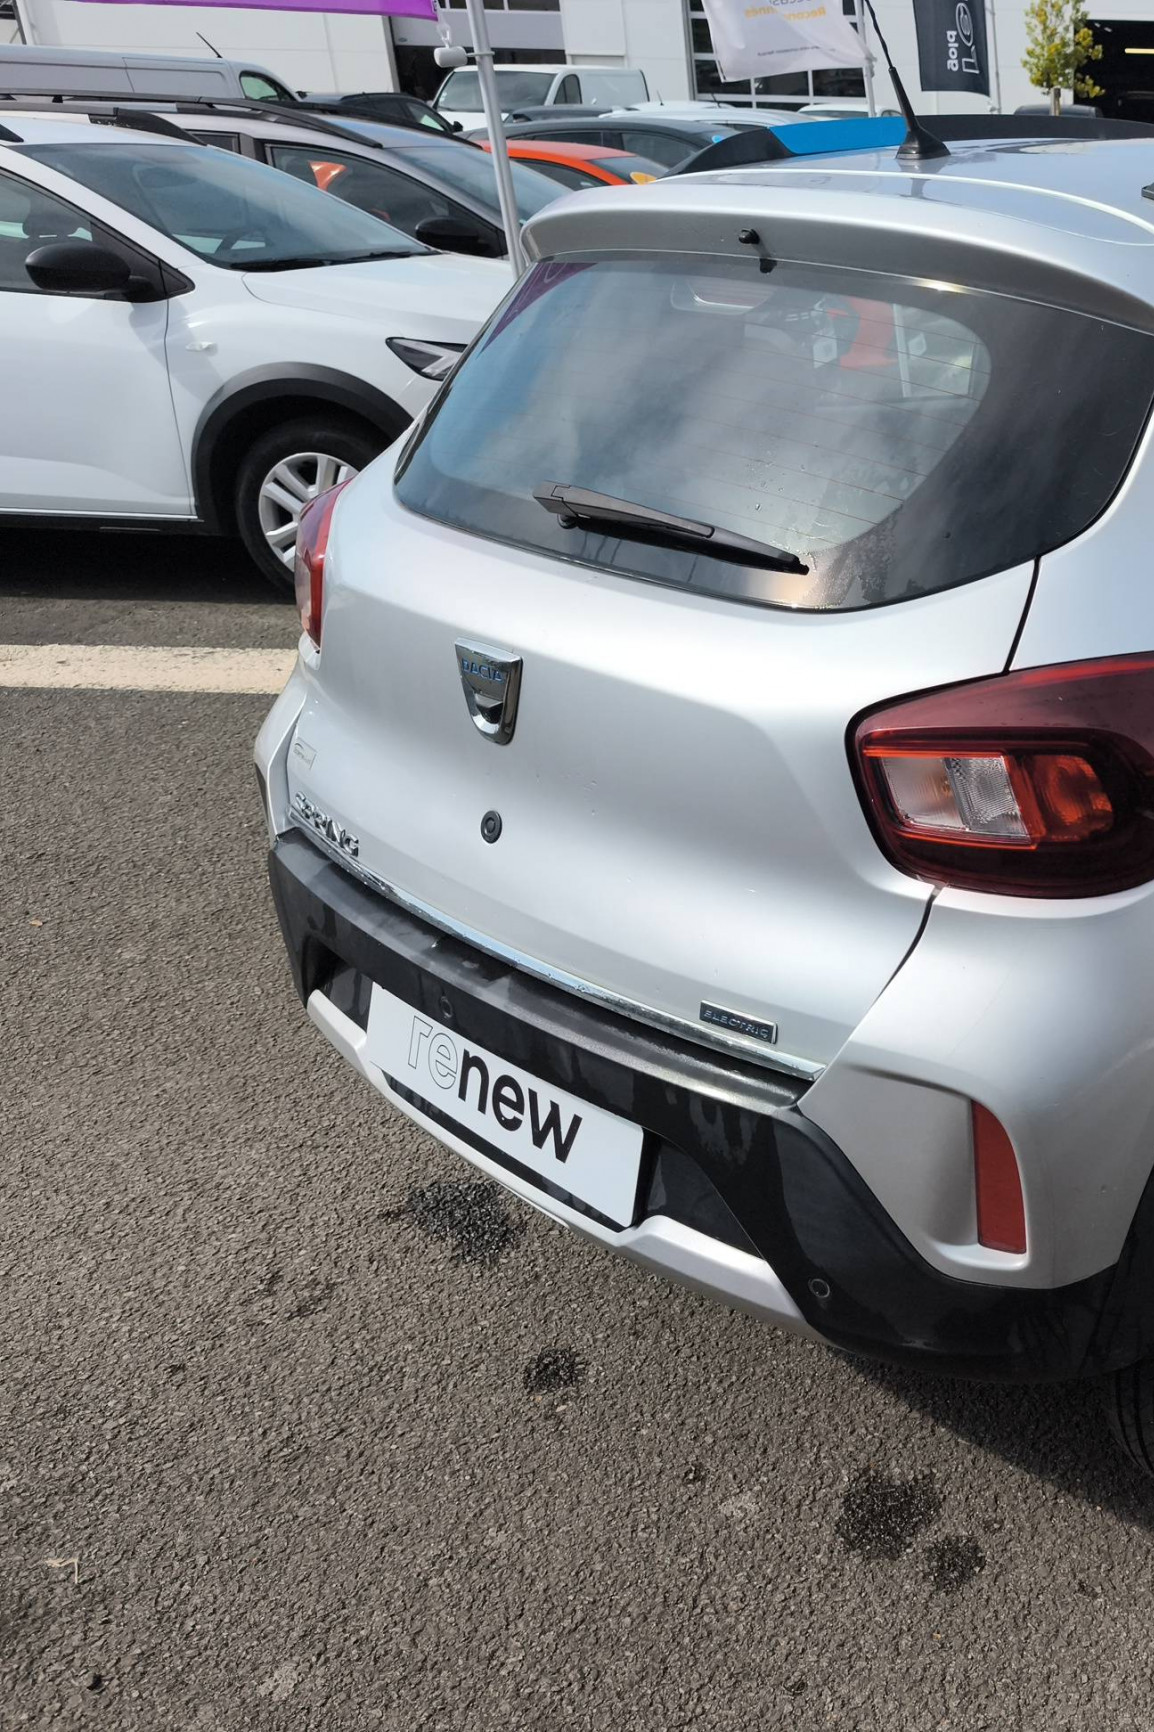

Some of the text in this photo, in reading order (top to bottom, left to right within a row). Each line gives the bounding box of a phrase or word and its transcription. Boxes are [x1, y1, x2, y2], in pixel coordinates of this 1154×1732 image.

[462, 657, 503, 683] DACIA
[703, 1010, 769, 1039] ELECTRIC
[408, 1015, 583, 1164] renew
